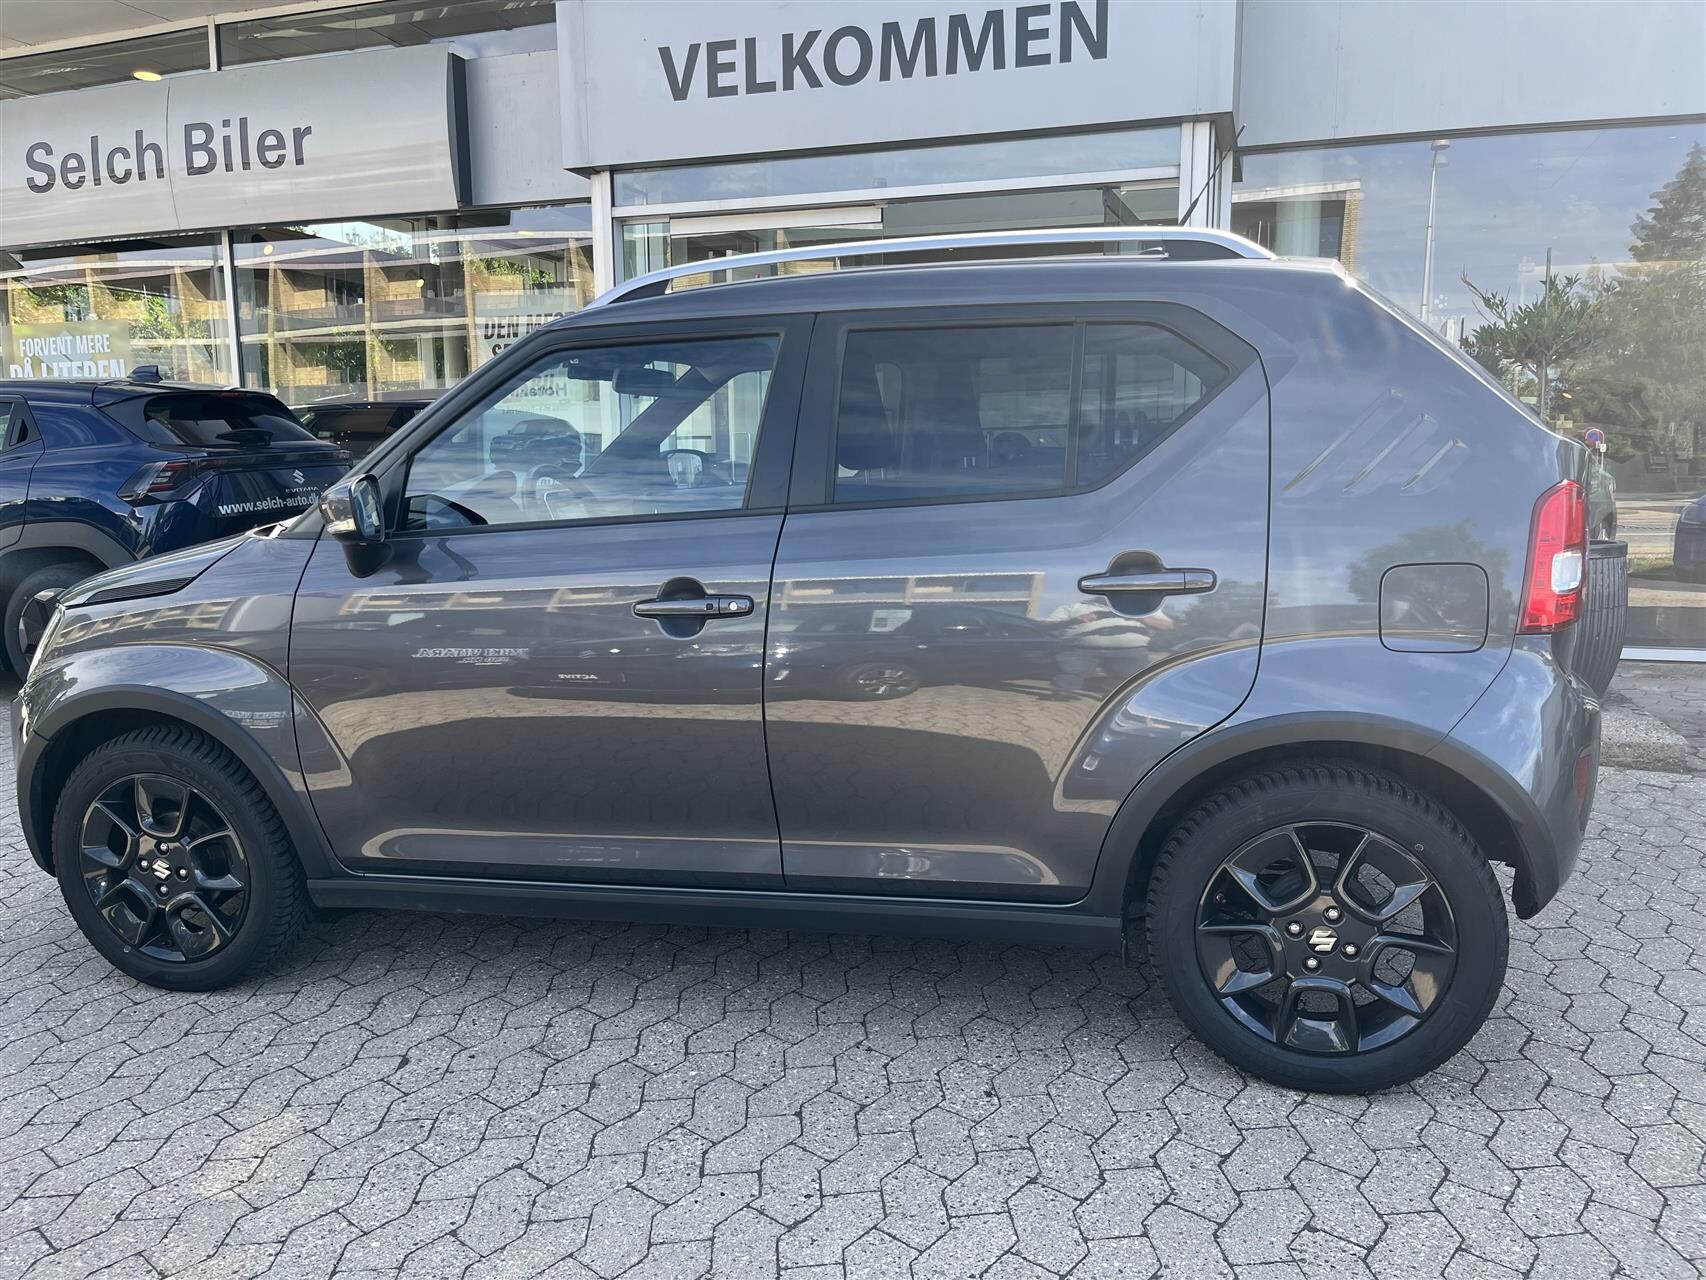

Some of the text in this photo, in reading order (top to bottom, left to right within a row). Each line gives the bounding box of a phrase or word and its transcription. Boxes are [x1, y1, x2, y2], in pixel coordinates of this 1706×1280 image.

[658, 0, 1108, 101] VELKOMMEN
[25, 117, 312, 193] Selch Biler
[484, 314, 519, 340] DEN
[20, 333, 111, 357] FORVENT MERE
[218, 493, 320, 515] www.selch-auto.dk
